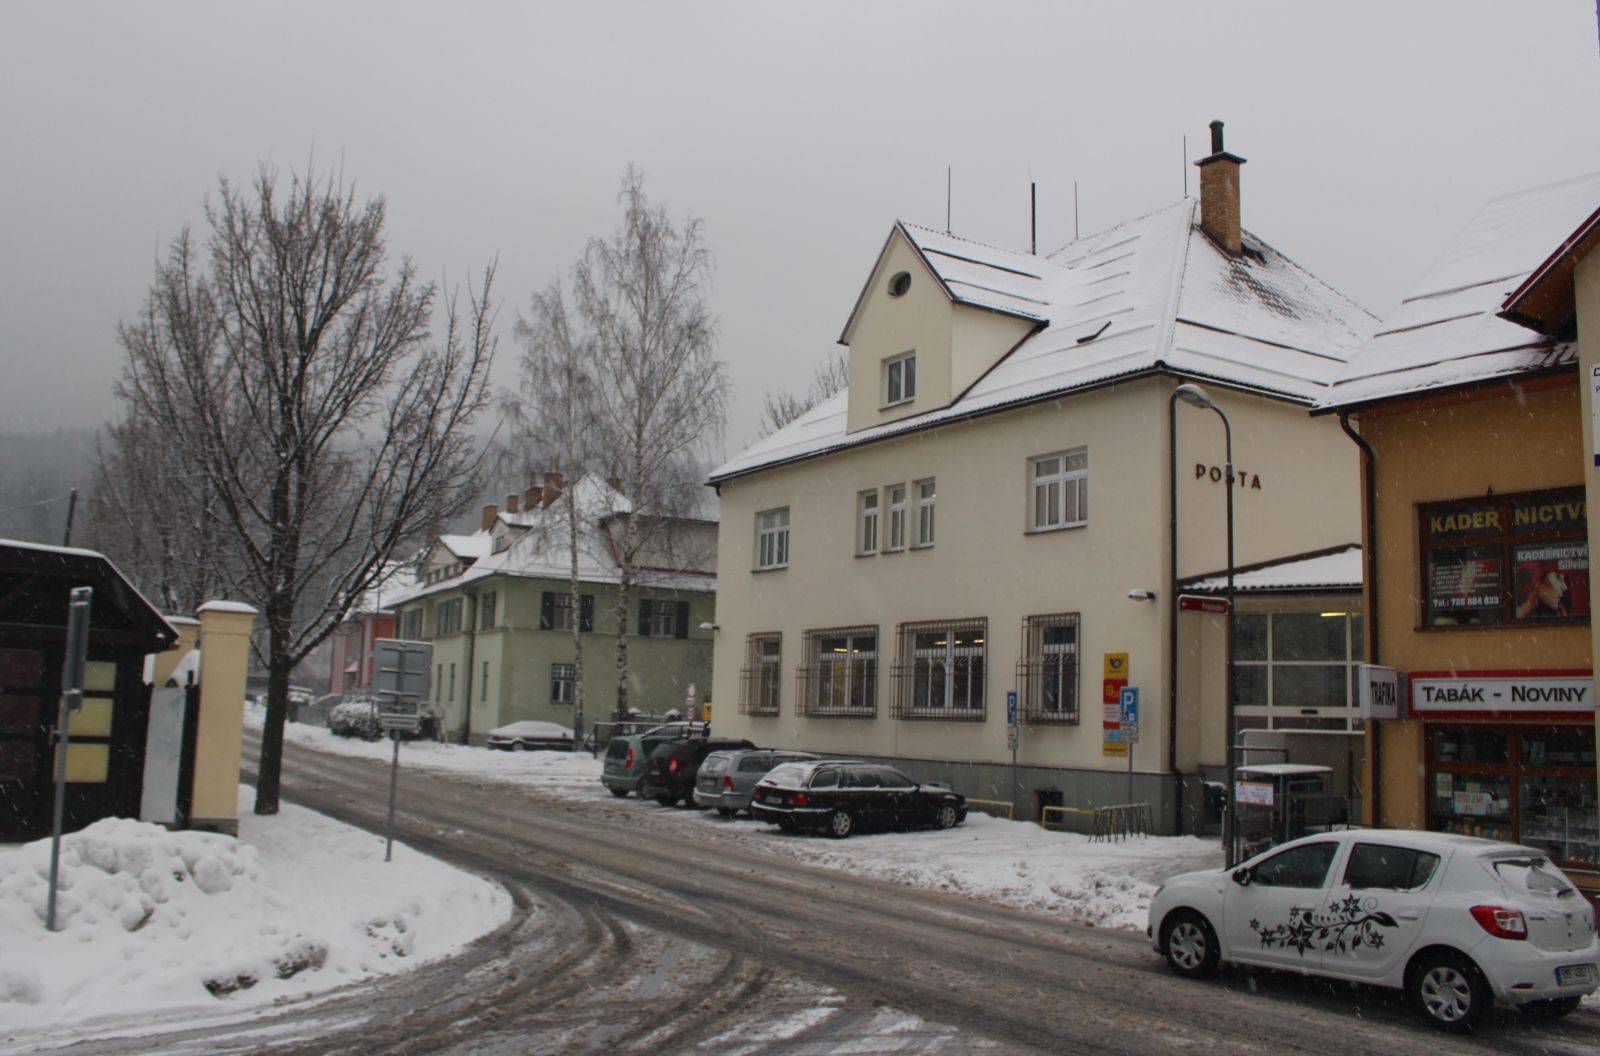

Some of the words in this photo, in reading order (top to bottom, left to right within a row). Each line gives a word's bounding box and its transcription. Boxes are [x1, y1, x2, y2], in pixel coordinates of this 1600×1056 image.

[1430, 506, 1500, 533] KADEŘ
[1370, 680, 1396, 706] TRAFIKA
[1422, 684, 1485, 703] TABÁK
[1511, 685, 1587, 703] NOVINY
